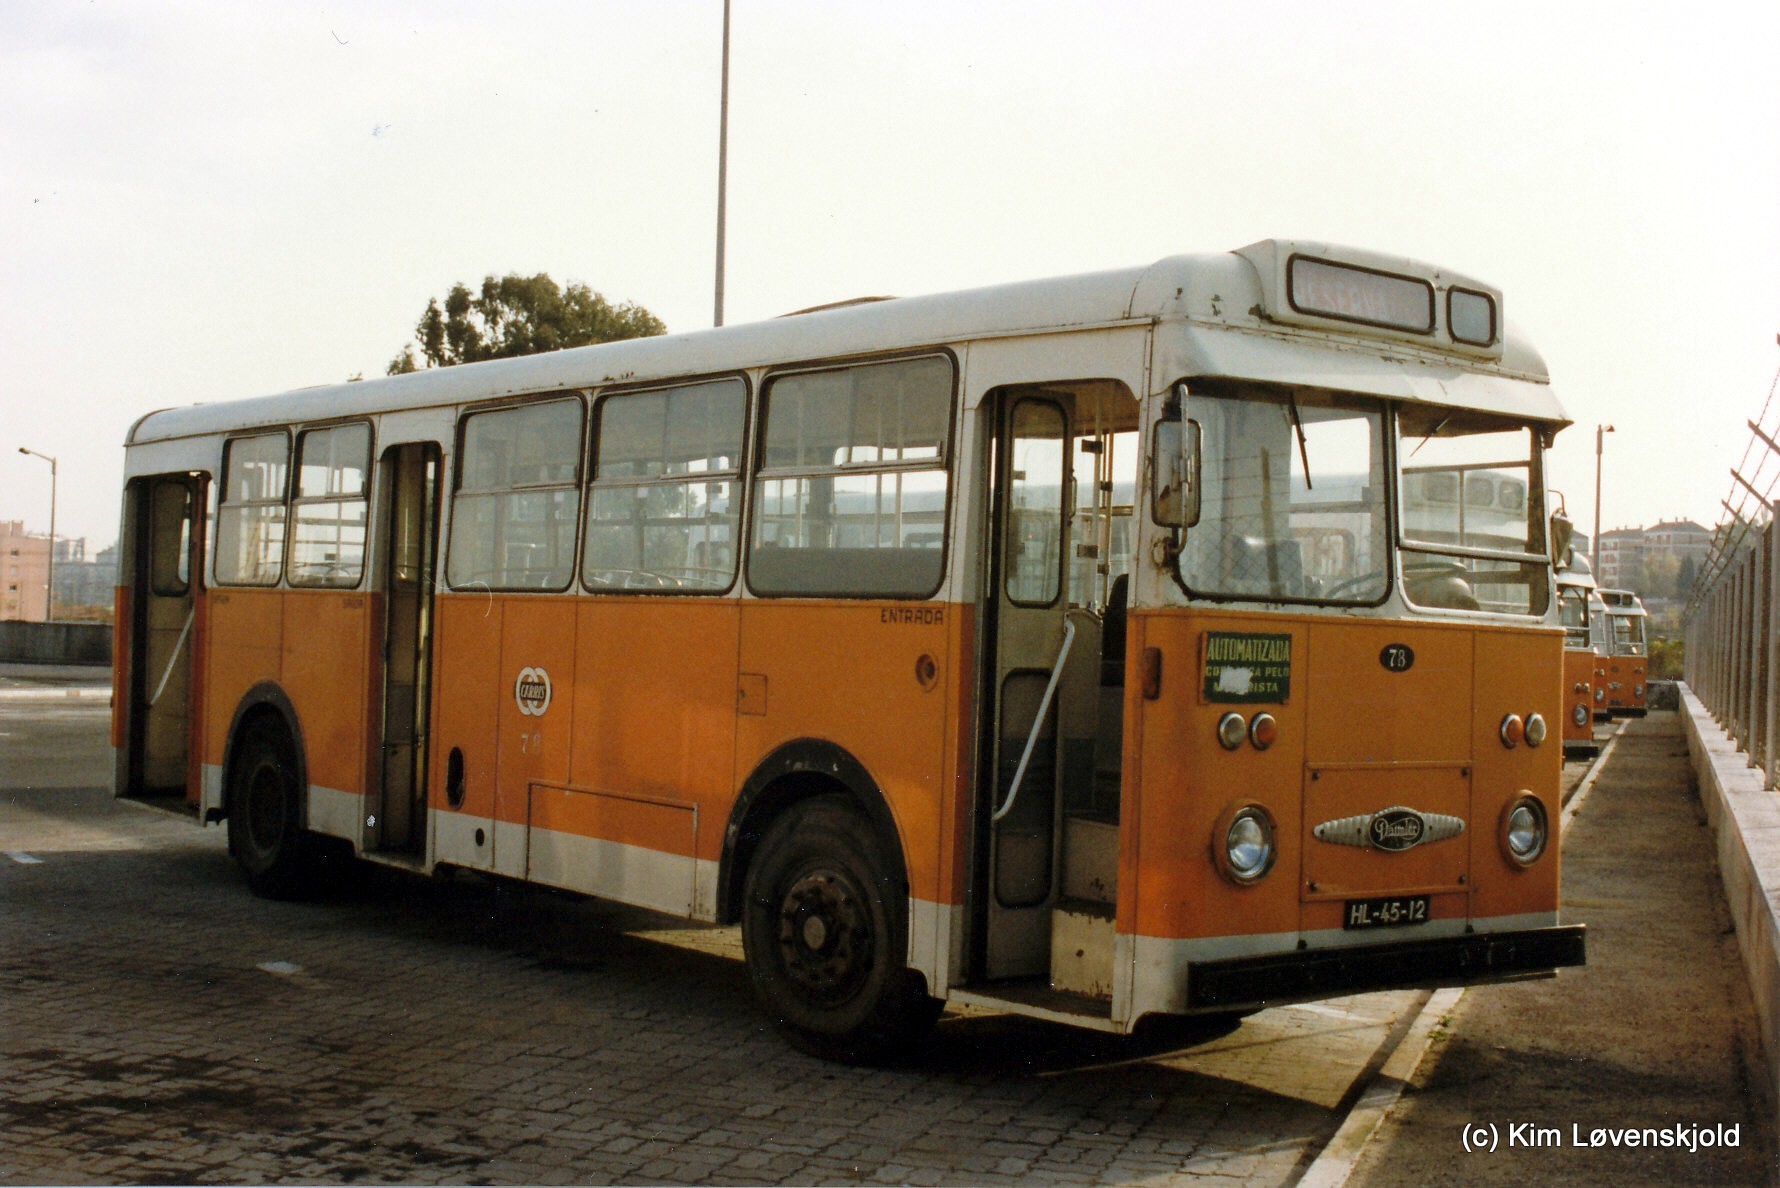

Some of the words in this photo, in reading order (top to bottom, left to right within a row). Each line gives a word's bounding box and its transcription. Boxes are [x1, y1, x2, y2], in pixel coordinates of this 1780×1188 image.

[881, 607, 944, 625] ENTRADA
[1206, 638, 1289, 661] AUTOMATIZADA
[1388, 649, 1406, 667] 78
[520, 684, 546, 699] CARRIS
[1374, 817, 1421, 841] Daimler
[1350, 900, 1425, 925] HL-45-12
